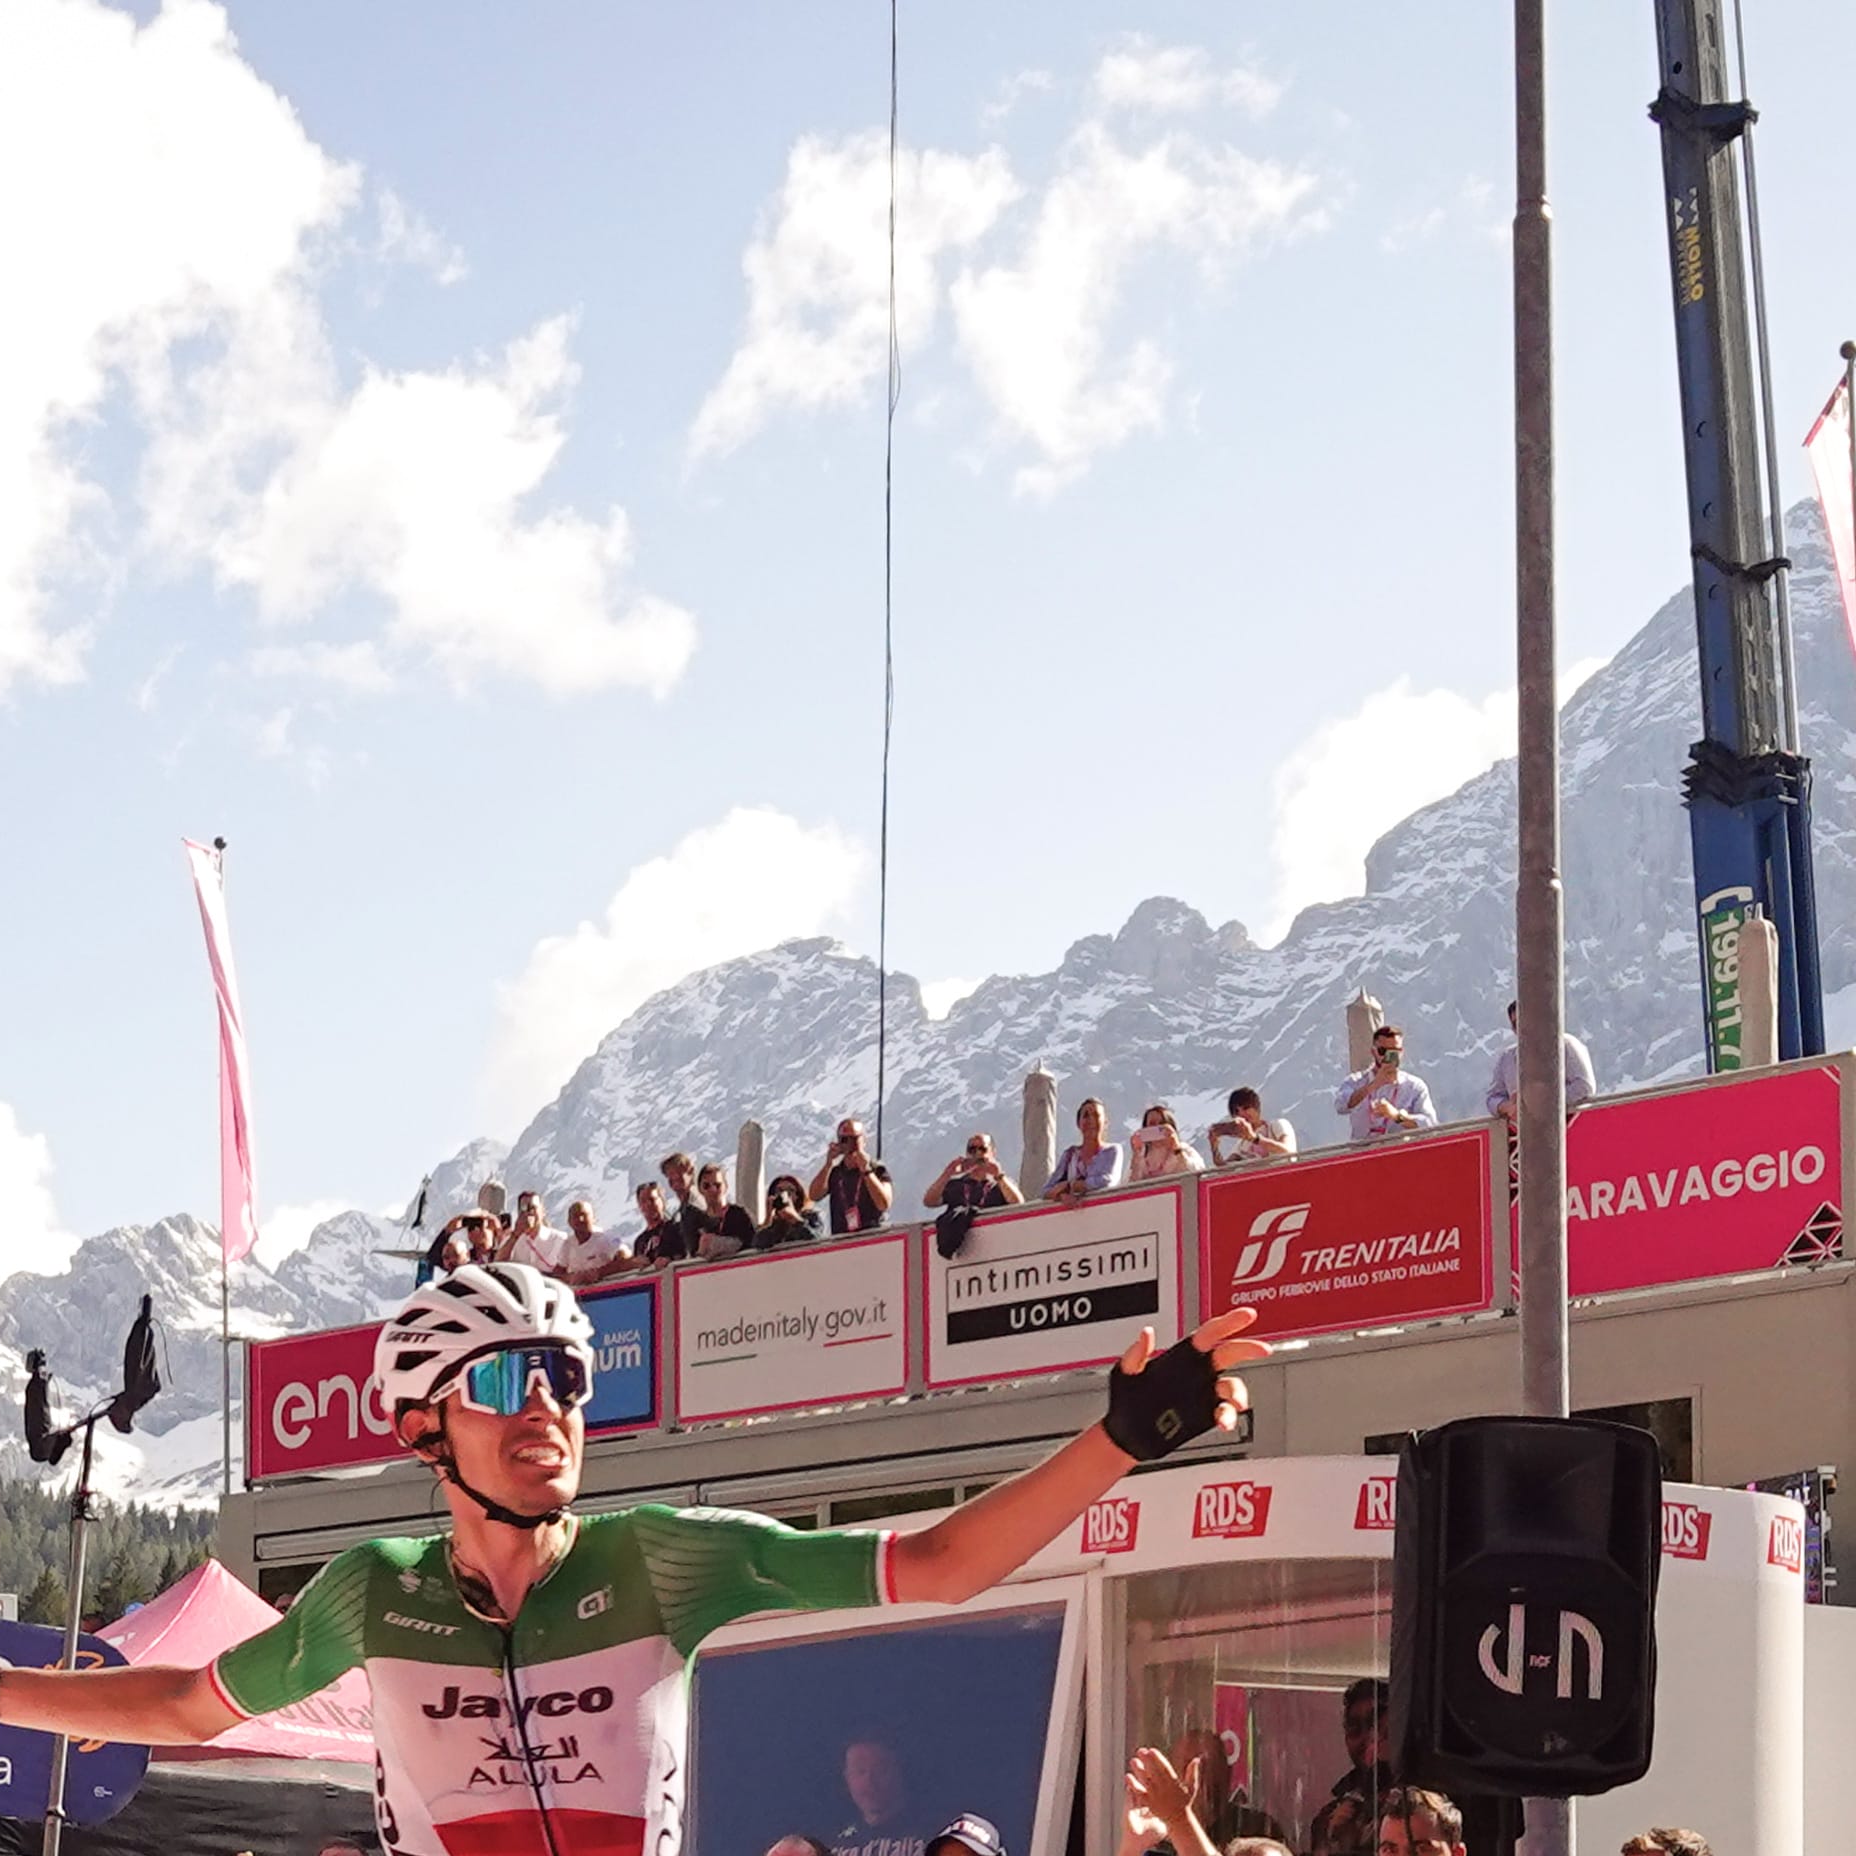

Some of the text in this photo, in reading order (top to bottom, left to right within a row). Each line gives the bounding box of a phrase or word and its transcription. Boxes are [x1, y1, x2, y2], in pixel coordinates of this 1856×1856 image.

[1567, 1144, 1826, 1223] ARAVAGGIO
[1300, 1226, 1461, 1274] TRENITALIA
[953, 1246, 1151, 1300] intimissimi
[1231, 1258, 1461, 1304] GRUPPO FERROVIE DELLO STATO ITALIANE
[1009, 1296, 1092, 1331] UOMO
[1087, 1501, 1129, 1545] RDS
[1199, 1484, 1255, 1529] RDS
[1774, 1517, 1801, 1562] RDS
[382, 1611, 461, 1636] GIANT
[422, 1686, 615, 1728] Jayco
